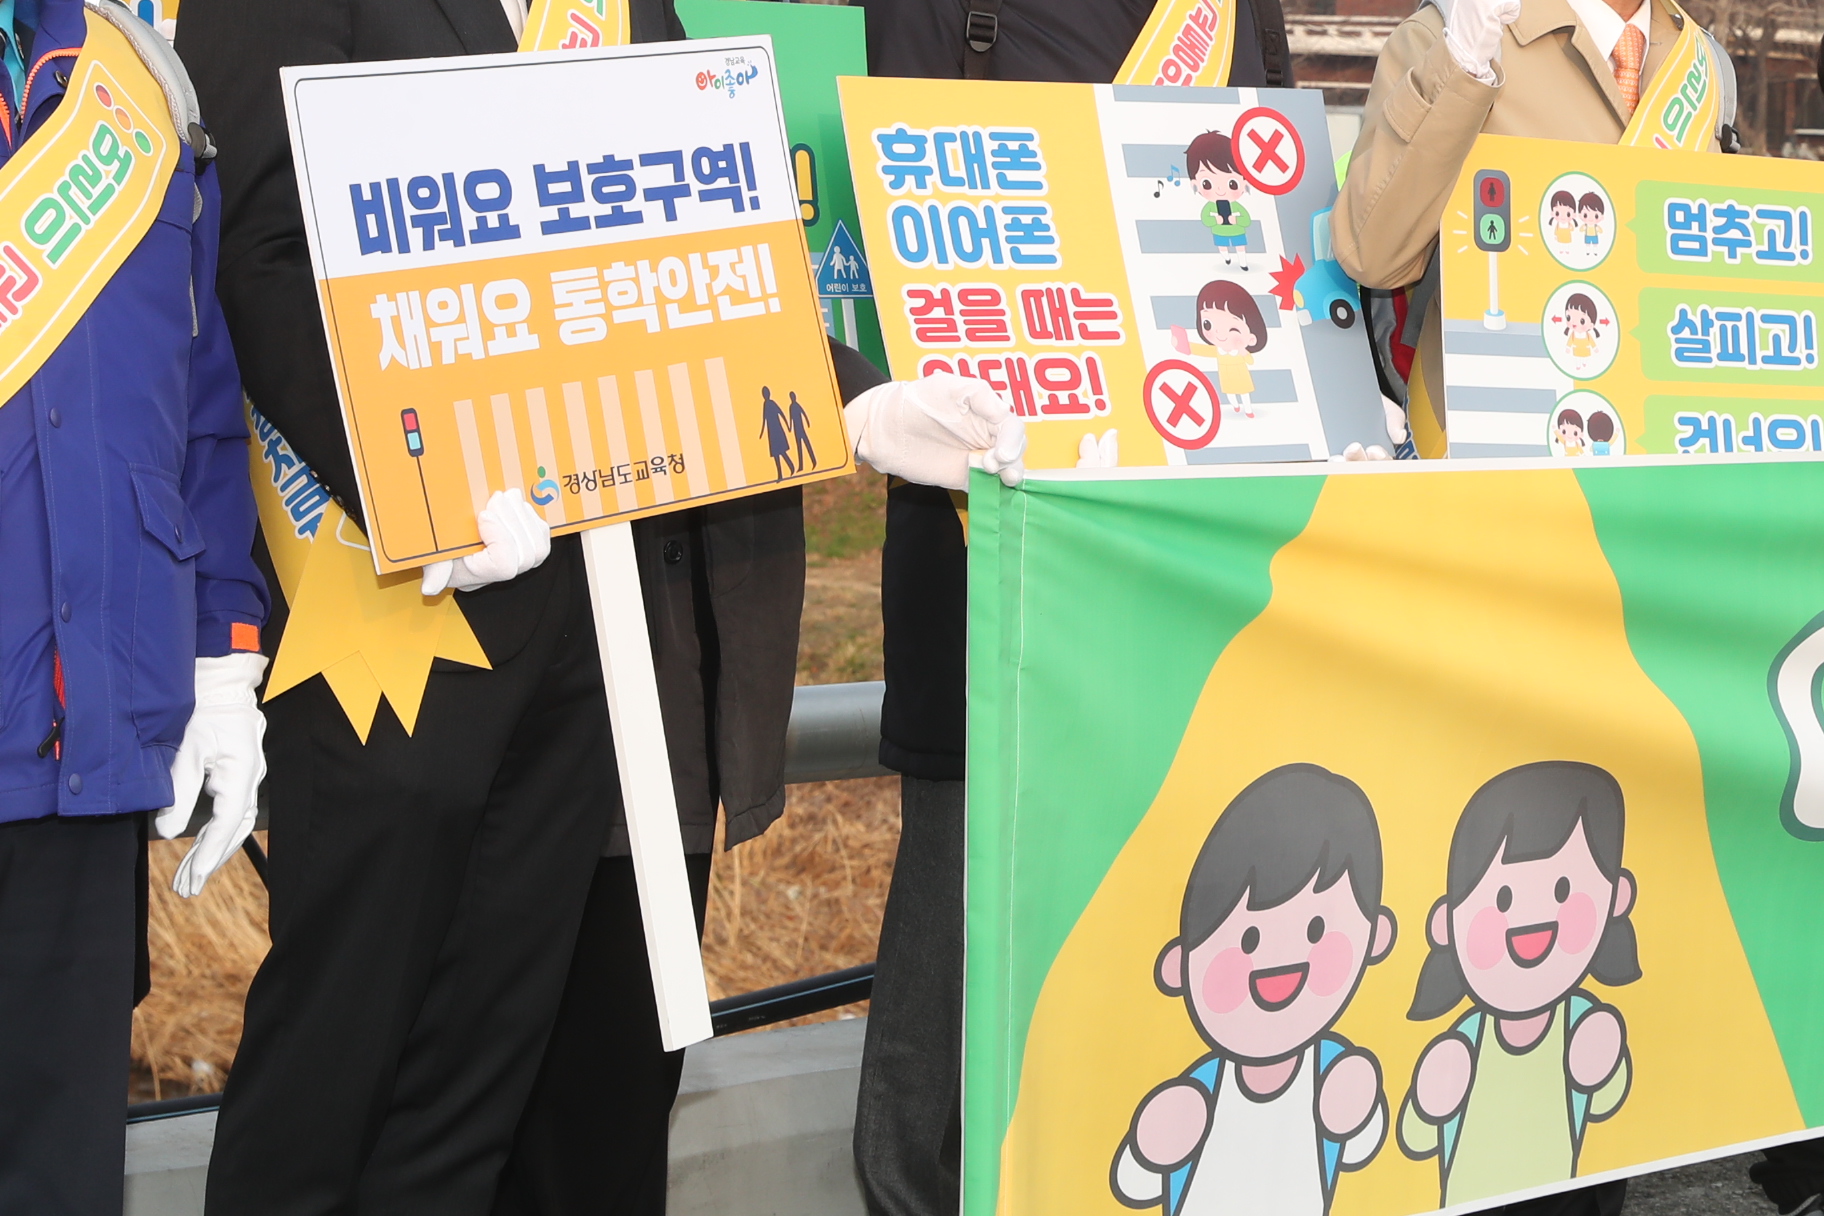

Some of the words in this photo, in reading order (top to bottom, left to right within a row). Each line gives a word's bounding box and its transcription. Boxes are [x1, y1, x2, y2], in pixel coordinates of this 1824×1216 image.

[695, 66, 759, 99] 아이좋아
[876, 127, 1049, 192] 휴대폰
[25, 123, 132, 265] 어린이
[348, 167, 522, 256] 비워요
[532, 141, 761, 237] 보호구역!
[891, 203, 1059, 266] 이어폰
[1667, 200, 1810, 263] 멈추고!
[370, 277, 540, 372] 채워요
[549, 242, 782, 347] 통학안전!
[826, 282, 849, 293] 어린이
[851, 283, 867, 292] 보호
[906, 287, 1011, 343] 걸을
[1020, 287, 1121, 341] 때는
[1670, 307, 1816, 366] 살피고!
[562, 451, 687, 496] 경상남도교육청
